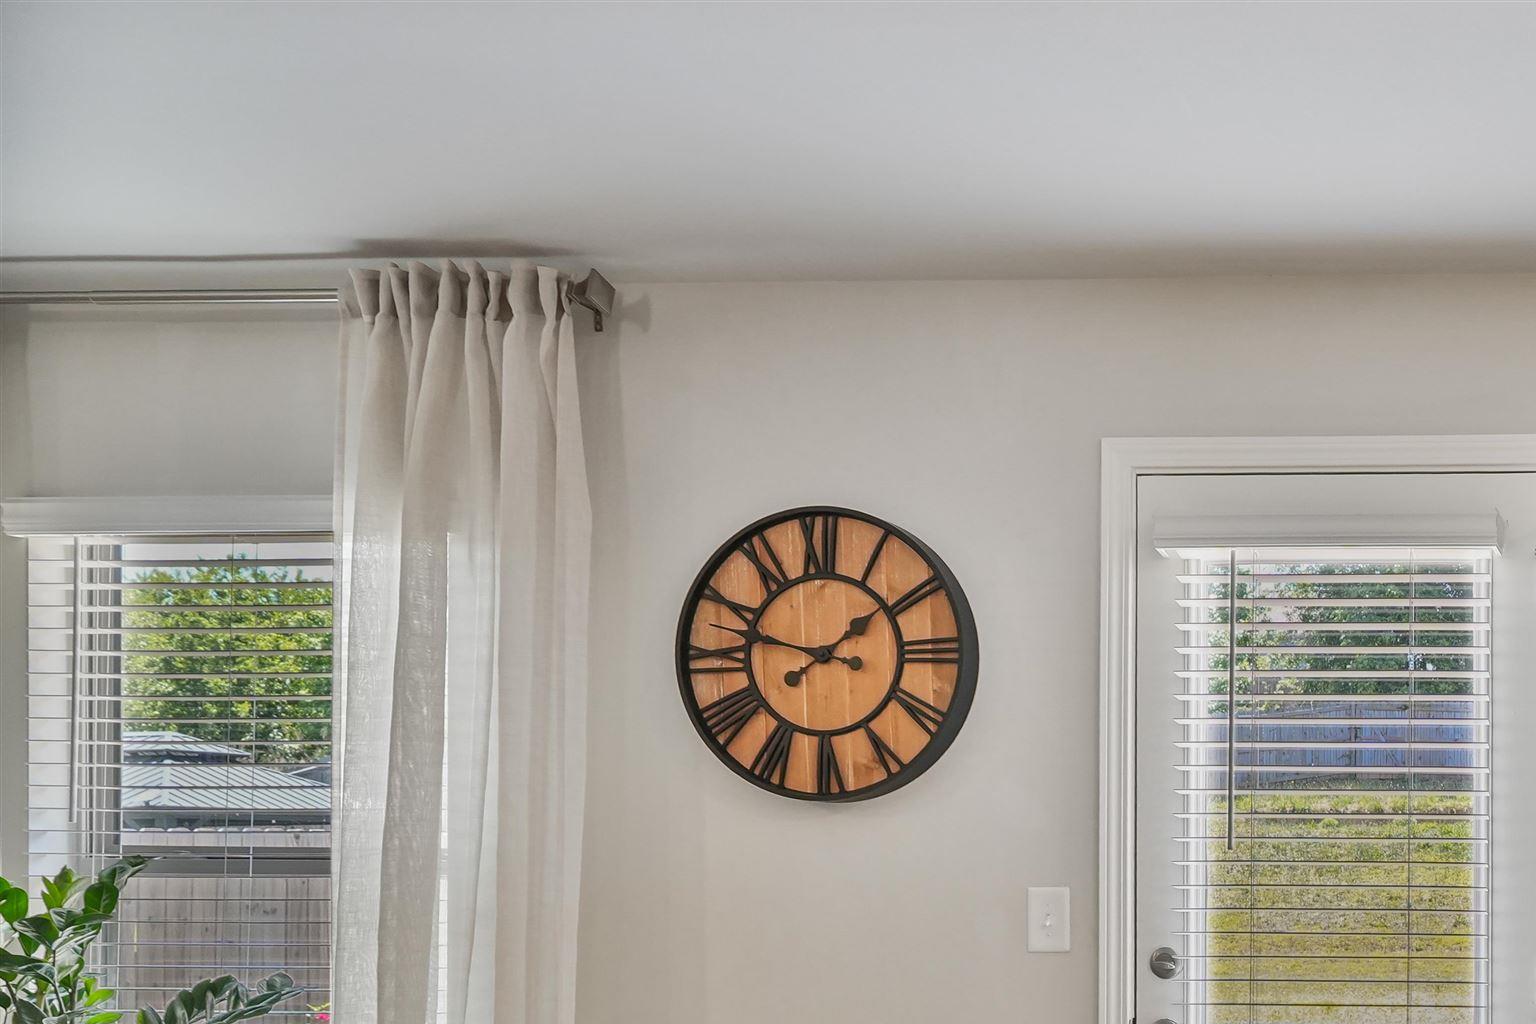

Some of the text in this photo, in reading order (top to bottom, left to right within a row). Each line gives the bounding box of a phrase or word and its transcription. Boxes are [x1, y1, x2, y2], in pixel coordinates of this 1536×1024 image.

[737, 531, 790, 596] XI
[799, 514, 838, 574] XII
[860, 529, 890, 584] I
[699, 583, 759, 624] X
[889, 574, 946, 617] II
[688, 643, 747, 674] IX
[902, 636, 960, 663] III
[700, 685, 762, 750] VIII
[750, 725, 794, 788] VII
[817, 733, 846, 794] VI
[863, 723, 907, 778] V
